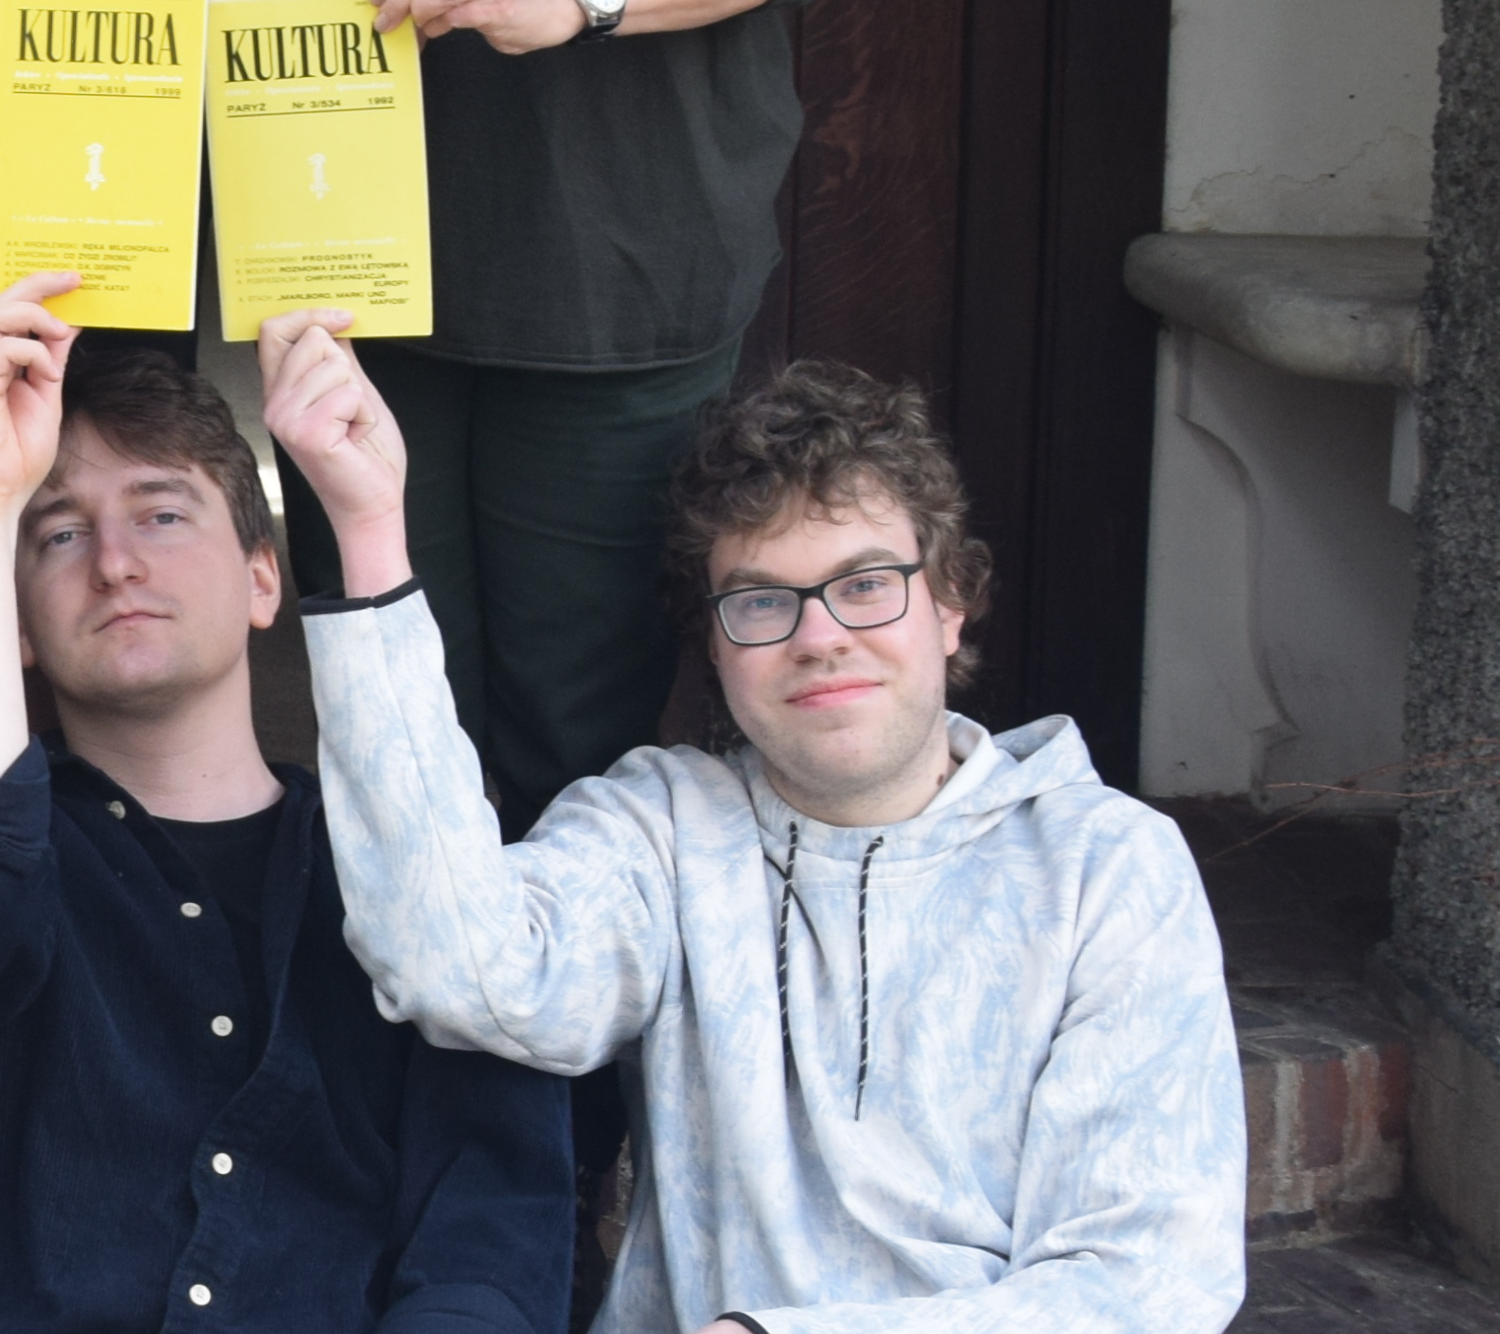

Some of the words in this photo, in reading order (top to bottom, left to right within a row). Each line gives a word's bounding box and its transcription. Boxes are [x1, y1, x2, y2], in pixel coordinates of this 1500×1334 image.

[16, 8, 182, 66] KULTURA
[221, 21, 393, 83] KULTURA
[13, 82, 51, 91] PARYŻ
[79, 85, 92, 93] Nr
[227, 102, 266, 112] PARYŻ
[292, 101, 305, 109] Nr
[310, 99, 341, 108] 3/534
[368, 96, 394, 105] 1992
[302, 253, 373, 262] PROGNOSTYK
